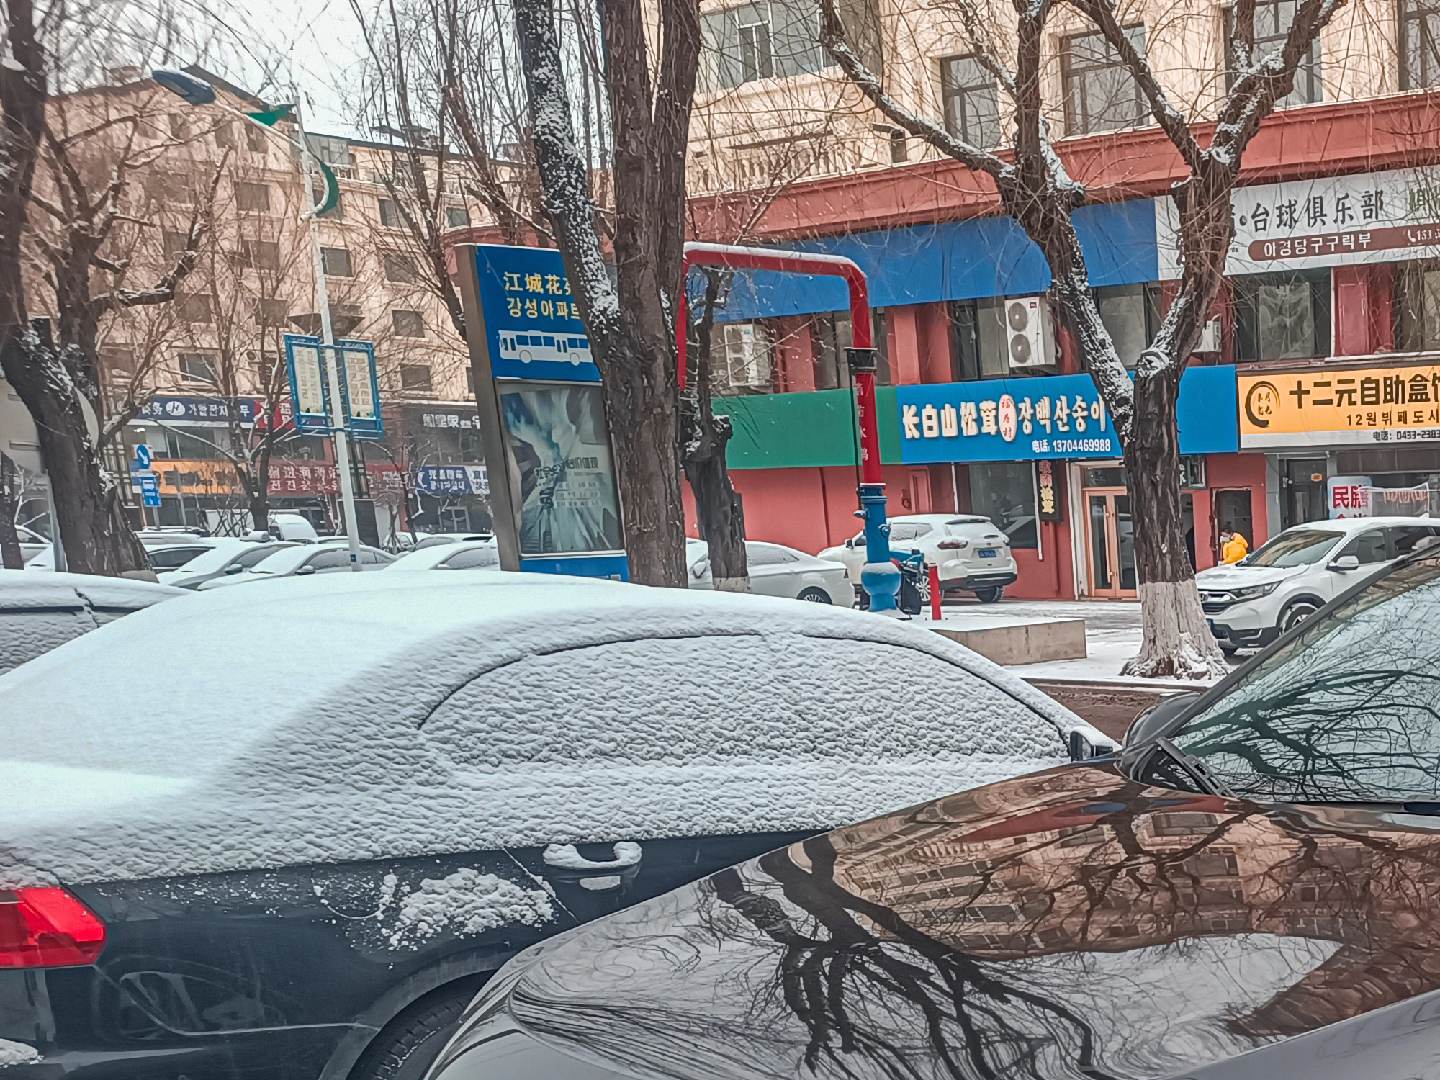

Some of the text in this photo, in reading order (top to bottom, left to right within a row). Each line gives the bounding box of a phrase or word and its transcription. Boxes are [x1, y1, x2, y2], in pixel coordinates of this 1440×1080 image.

[1251, 190, 1384, 233] 台球俱乐部
[507, 297, 580, 320] 강성아파트
[903, 400, 997, 439] 长白山松茸
[1018, 393, 1105, 435] 장백산송이
